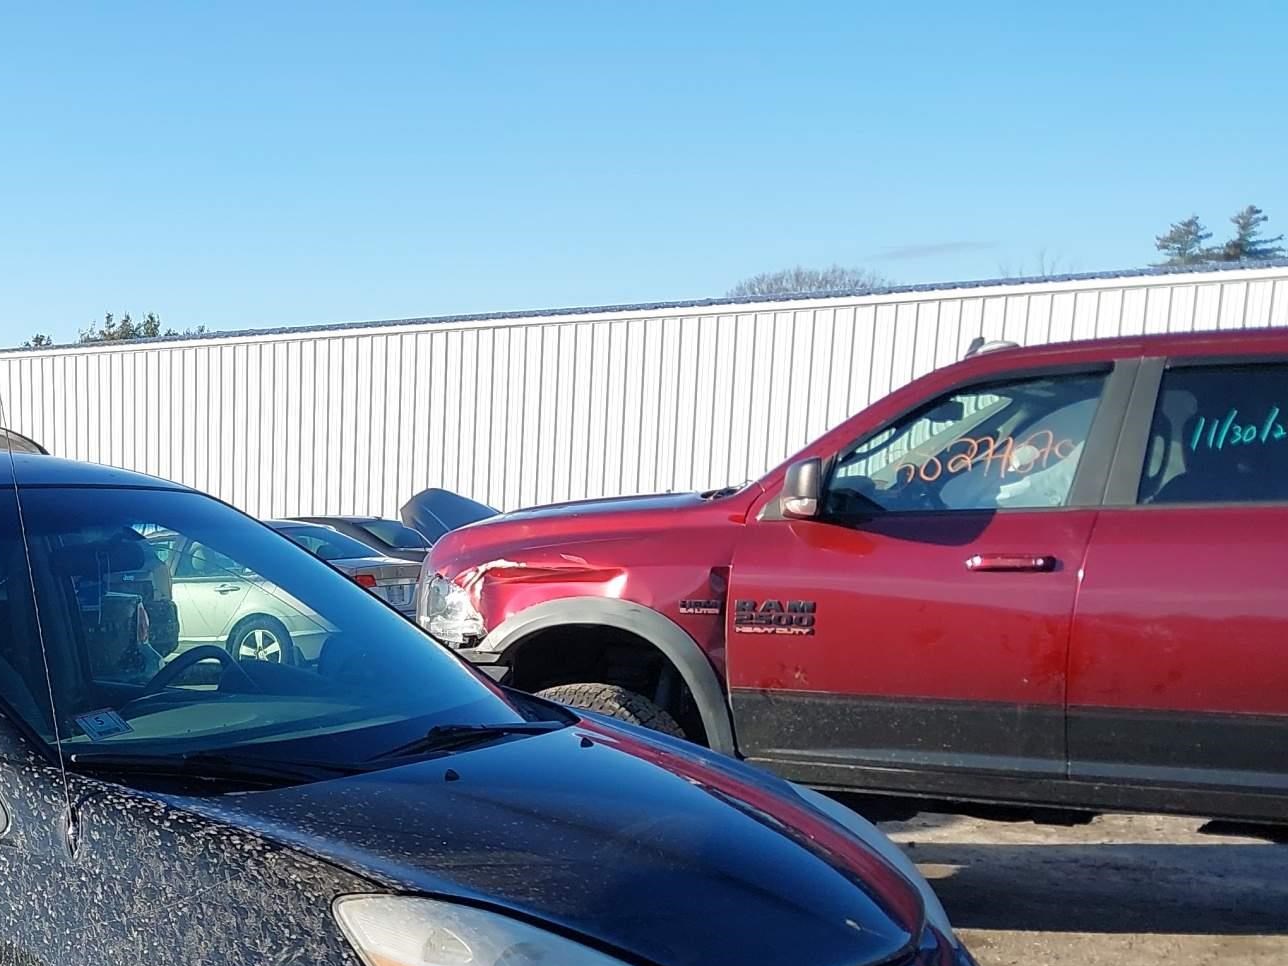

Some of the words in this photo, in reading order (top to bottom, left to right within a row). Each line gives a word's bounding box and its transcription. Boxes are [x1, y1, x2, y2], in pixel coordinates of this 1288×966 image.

[734, 599, 816, 614] RAM
[734, 613, 816, 626] 2500
[735, 626, 774, 634] HEAVY
[775, 627, 812, 636] DUTY
